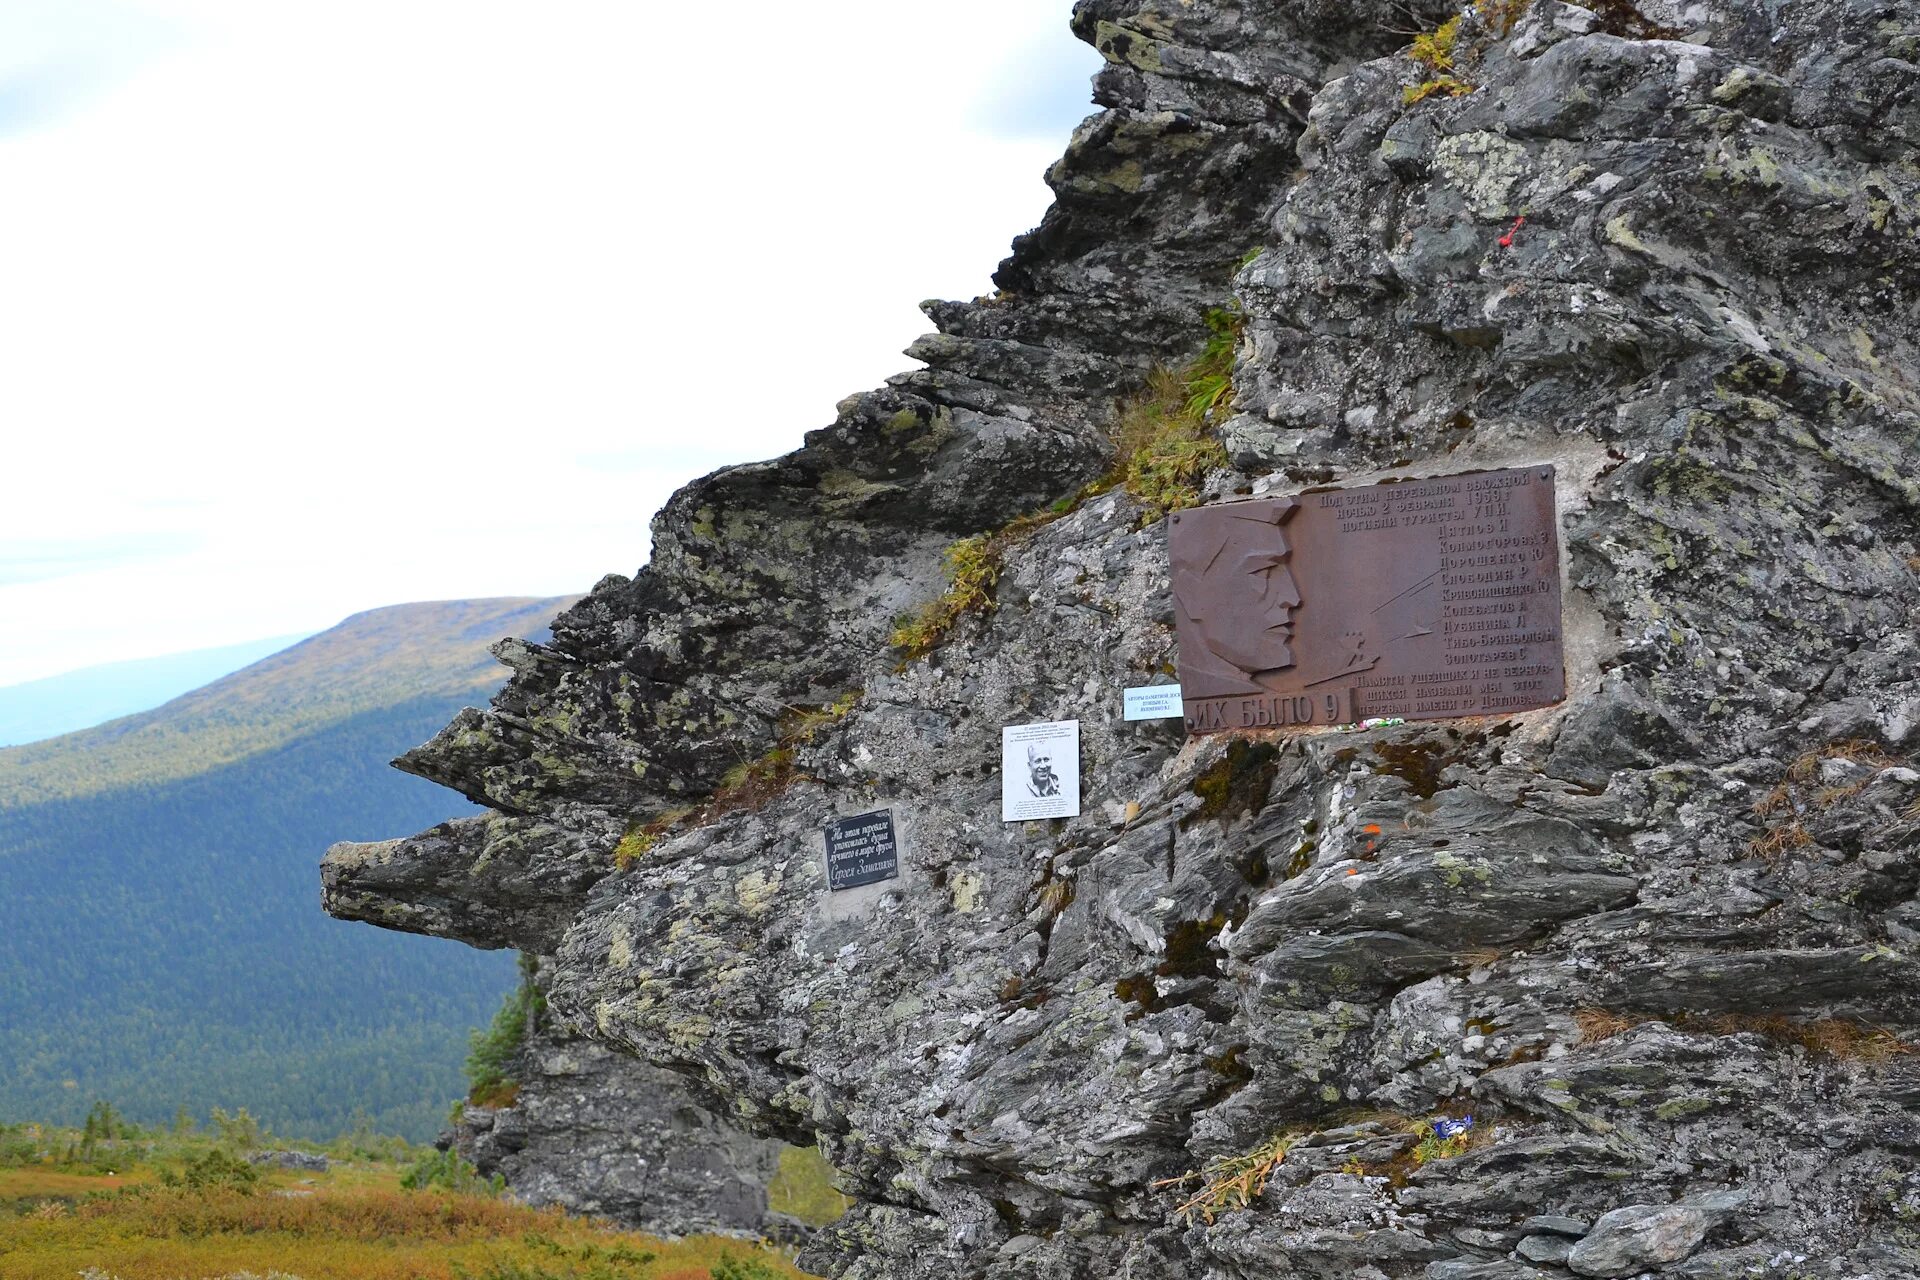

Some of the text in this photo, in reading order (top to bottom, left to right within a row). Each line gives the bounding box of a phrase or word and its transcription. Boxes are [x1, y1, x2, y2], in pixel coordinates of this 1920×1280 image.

[1320, 472, 1530, 508] ПОД ЭТИМ ПЕРЕВАЛОМ ВЬЮЖНОЙ
[1336, 505, 1376, 520] НОЧЬЮ
[1383, 502, 1391, 515] 2
[1397, 498, 1455, 513] ФЕВРАЛЯ
[1342, 518, 1397, 533] ПОГИБЛИ
[1402, 510, 1465, 526] ТУРИСТЫ
[1439, 518, 1508, 540] ДЯТЛОВ И
[1440, 531, 1549, 553] КОЛМОГОРОВА З
[1440, 548, 1544, 570] ДОРОШЕНКО Ю
[1441, 566, 1529, 585] СЛОБОДИН Р
[1537, 579, 1550, 593] Ю
[1442, 601, 1528, 618] КОЛЕВАТОВ А
[1443, 615, 1526, 635] ДУБИНИНА Л
[1444, 648, 1527, 666] ЗОЛОТАРЕВ С
[1357, 675, 1404, 688] ПАМЯТИ
[1410, 669, 1469, 685] УШЕДШИХ
[1471, 668, 1480, 680] И
[1483, 667, 1500, 679] НЕ
[1367, 679, 1543, 702] ШИХСЯ НАЗВАЛИ МЫ ЭТОТ
[1193, 694, 1340, 732] ИХ БЫЛО 9
[1359, 702, 1411, 717] ПЕРЕВАЛ
[1416, 700, 1457, 713] ИМЕНИ
[831, 827, 843, 841] На
